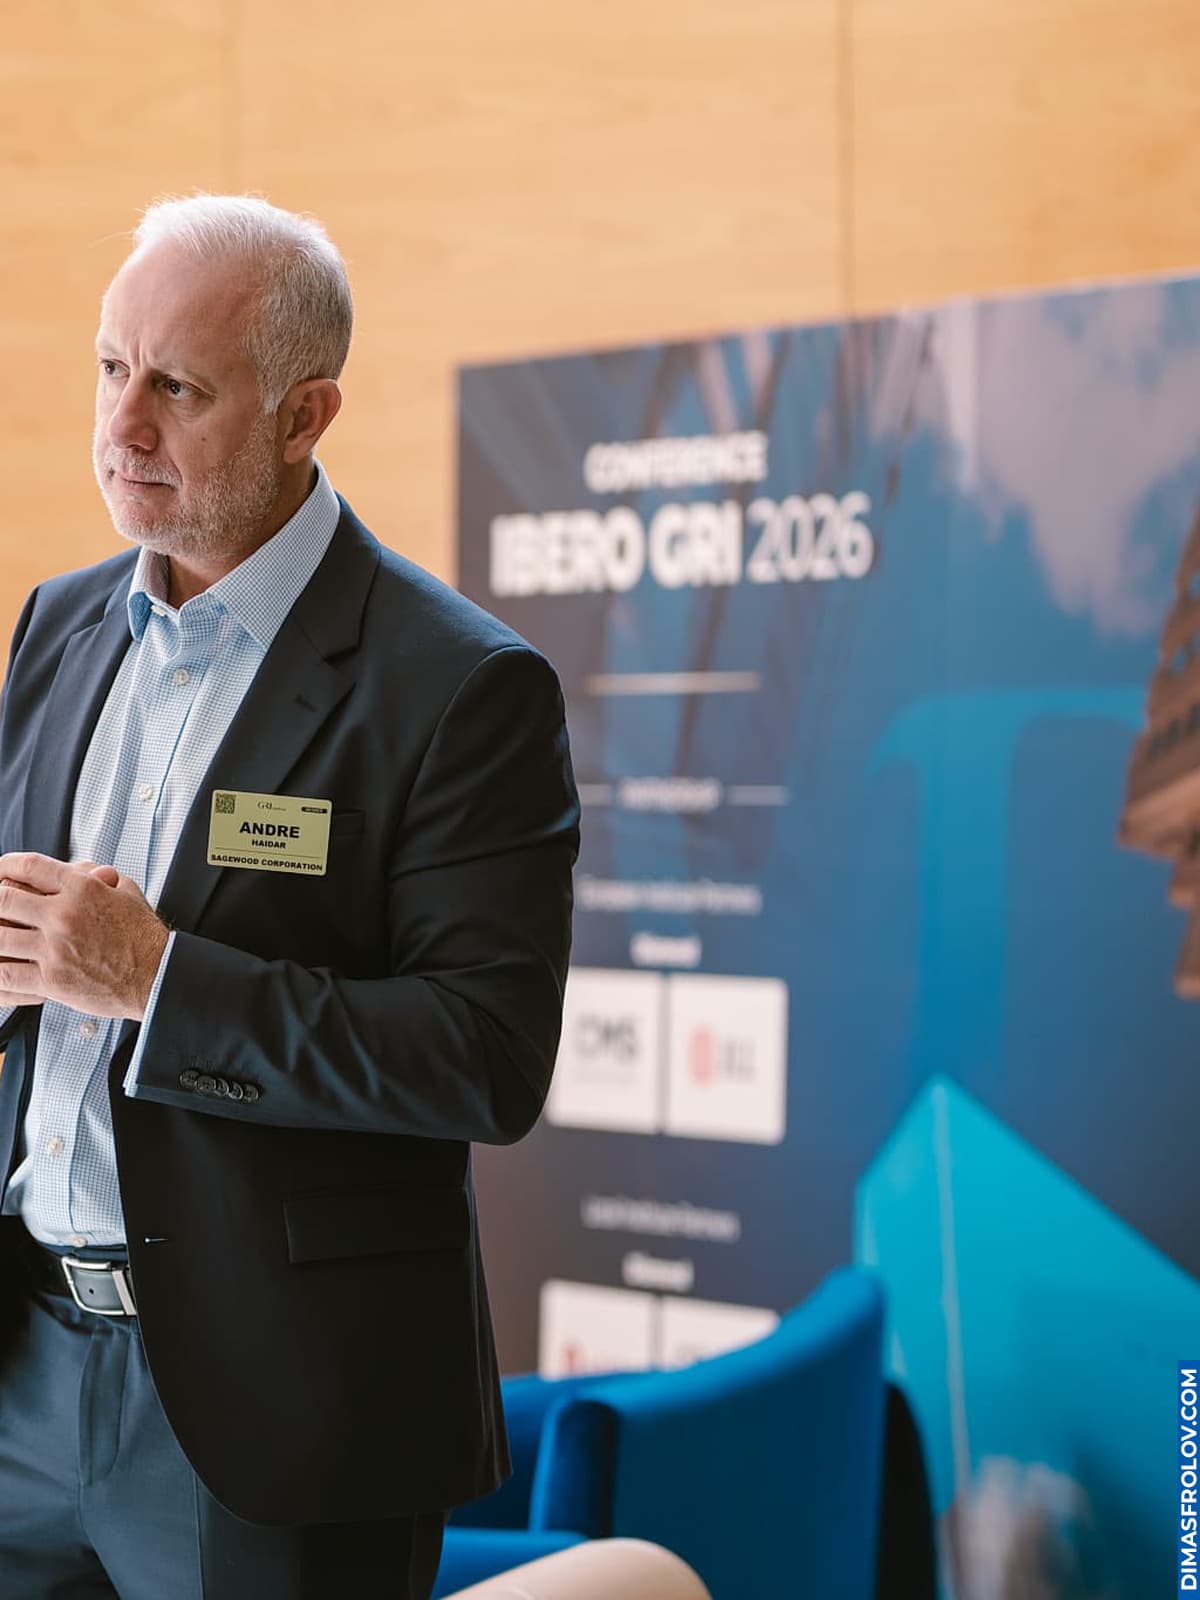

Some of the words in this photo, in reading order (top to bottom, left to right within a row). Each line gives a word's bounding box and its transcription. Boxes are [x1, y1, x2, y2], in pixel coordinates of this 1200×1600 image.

[583, 430, 768, 494] CONFERENCE
[490, 505, 645, 596] IBERO
[649, 502, 743, 588] GRI
[747, 491, 875, 583] 2026
[240, 821, 301, 839] ANDRE
[251, 839, 286, 850] HAIDAR
[211, 854, 260, 866] SAGEWOOD
[261, 858, 323, 872] CORPORATION
